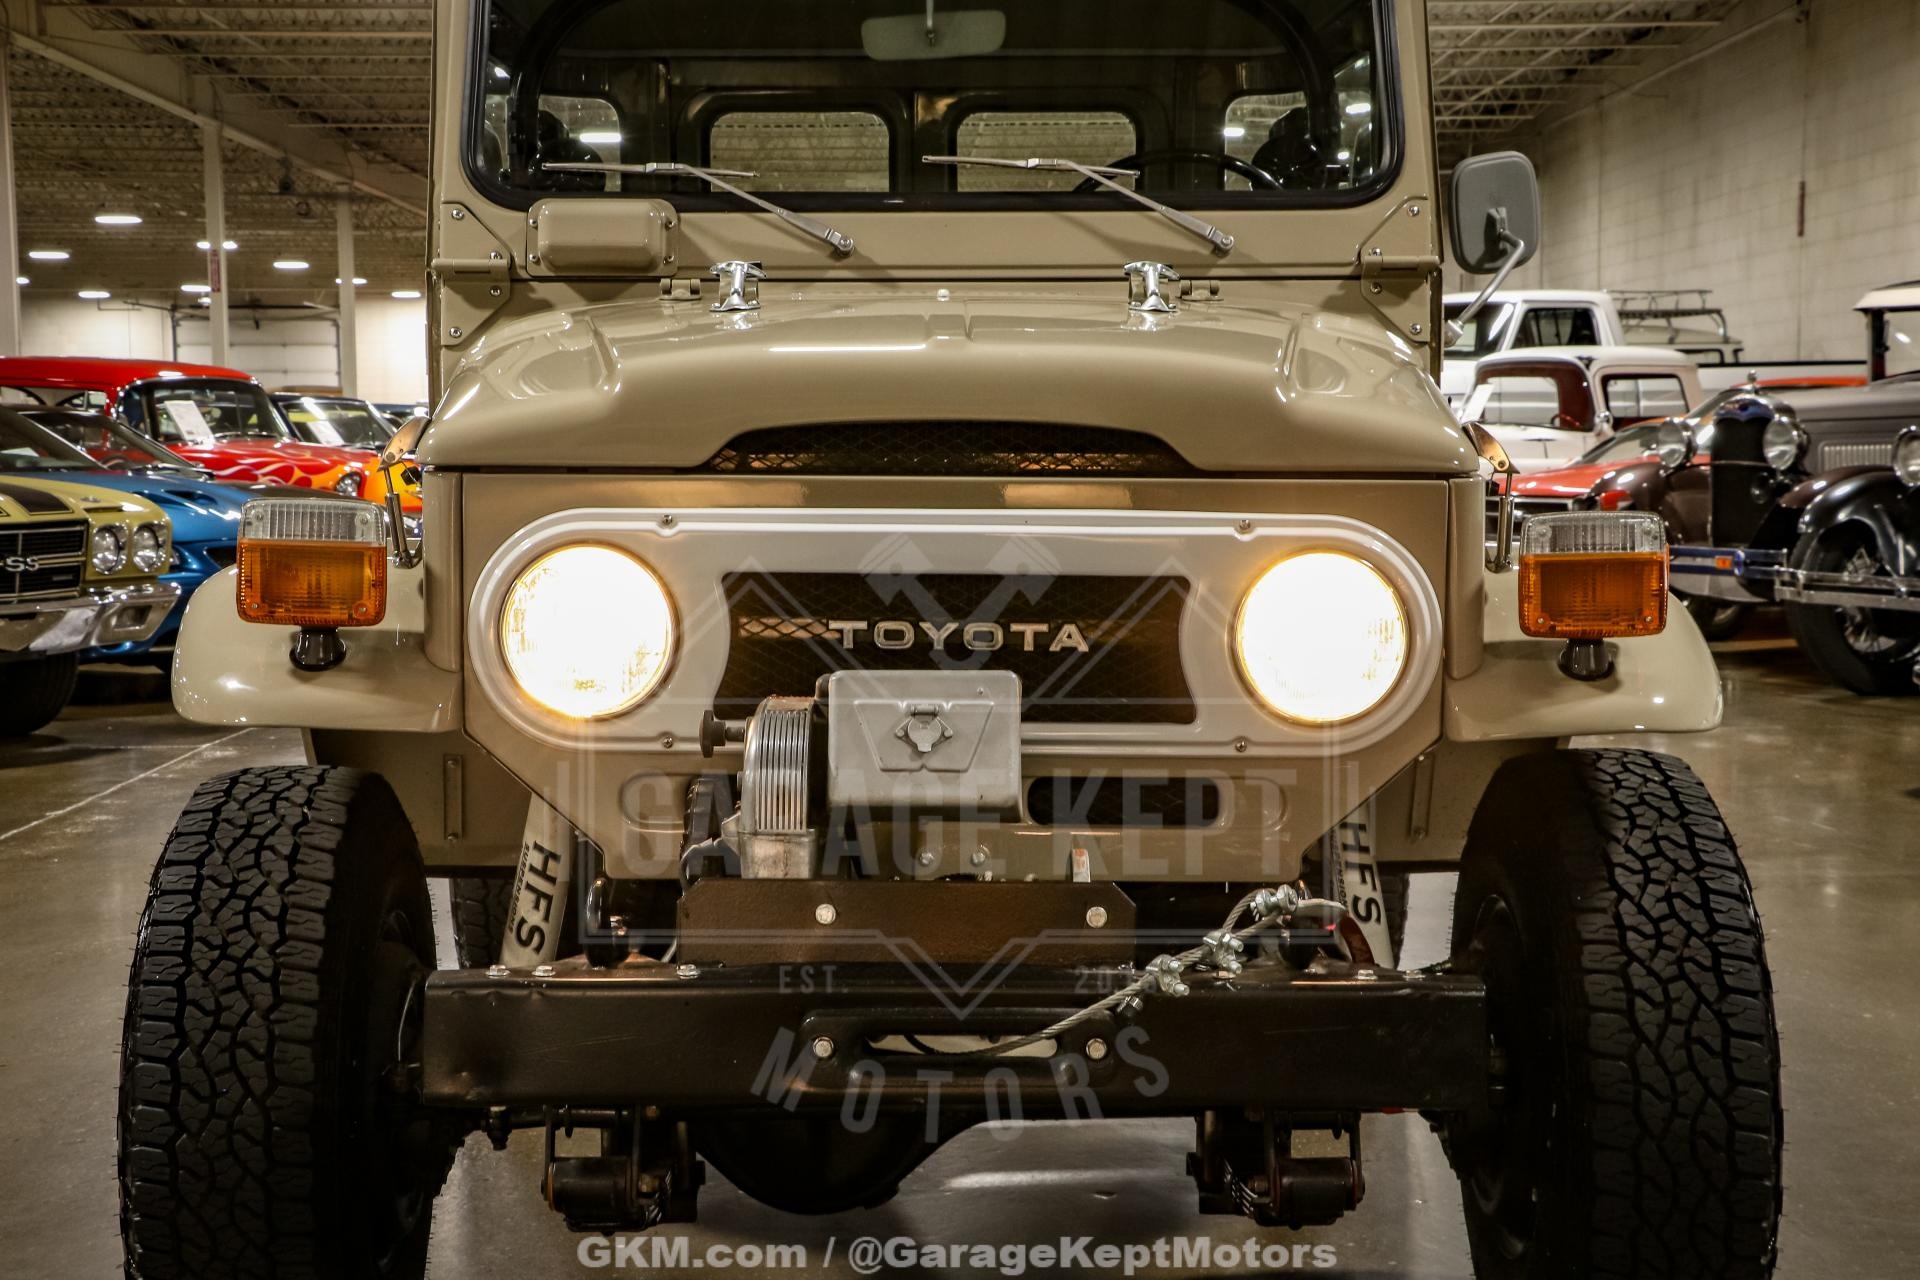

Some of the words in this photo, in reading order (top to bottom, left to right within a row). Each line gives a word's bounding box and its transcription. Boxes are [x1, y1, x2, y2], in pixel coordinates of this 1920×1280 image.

[828, 619, 1090, 652] TOYOTA
[509, 841, 531, 935] SUSPENSIONS
[515, 840, 562, 956] HFS
[1339, 821, 1382, 926] HFS
